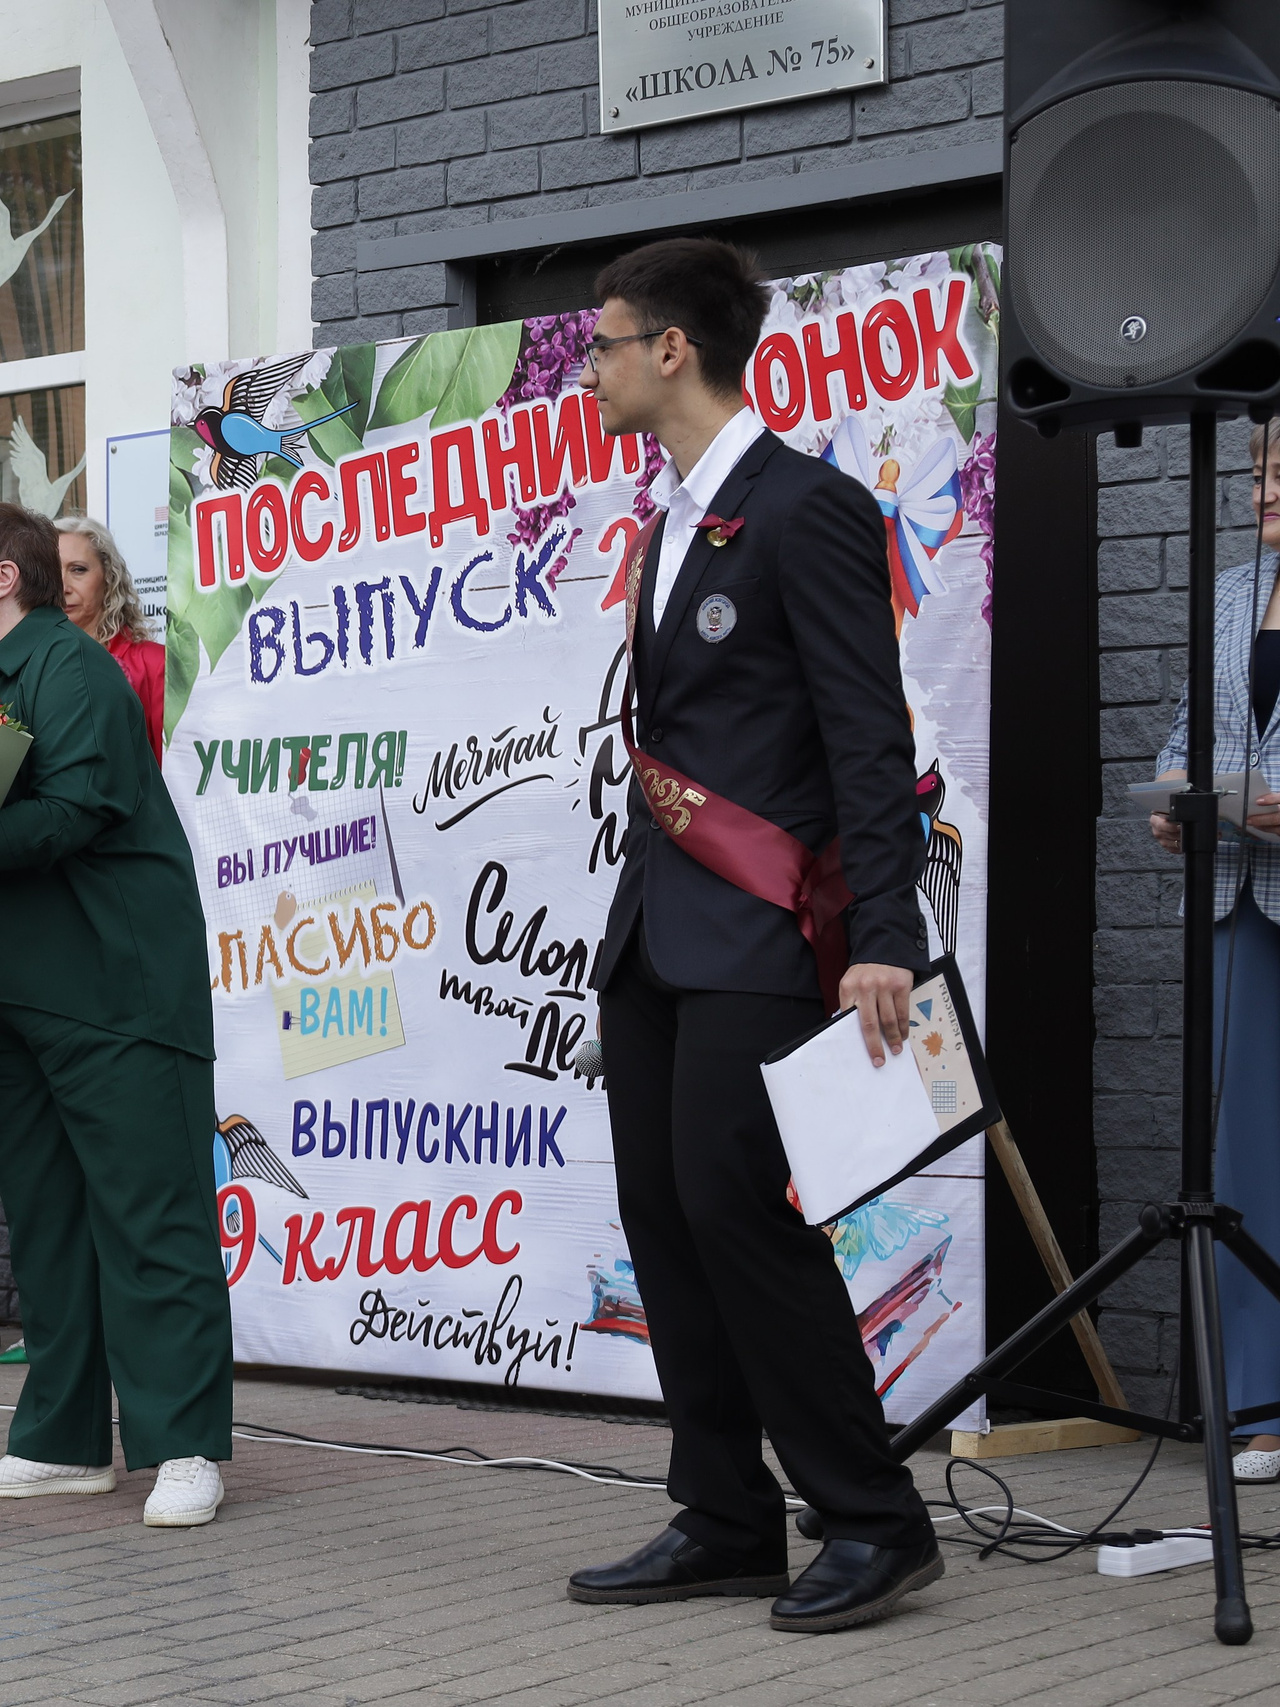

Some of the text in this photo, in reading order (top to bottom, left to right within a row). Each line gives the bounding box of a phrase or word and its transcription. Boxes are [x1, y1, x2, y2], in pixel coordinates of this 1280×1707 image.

[625, 0, 706, 18] МУНИЦИ
[649, 0, 798, 31] ОБЩЕОБРАЗОВАТЕ
[687, 11, 784, 41] УЧРЕЖДЕНИЕ
[625, 37, 855, 103] «ШКОЛА № 75»
[741, 280, 974, 432] ОНОК
[247, 524, 567, 685] ВЫПУСК
[194, 730, 408, 796] УЧИТЕЛЯ!
[413, 706, 562, 814] Мечтай
[218, 815, 377, 889] ВЫ ЛУЧШИЕ!
[210, 901, 437, 992] ПАСИБО
[465, 861, 605, 1001] Сегод
[299, 986, 388, 1038] ВАМ!
[439, 969, 533, 1029] твой
[938, 983, 964, 1051] 9 классы
[292, 1098, 567, 1169] ВЫПУСКНИК
[217, 1184, 523, 1287] 9 класс
[350, 1274, 580, 1387] Действуй!
